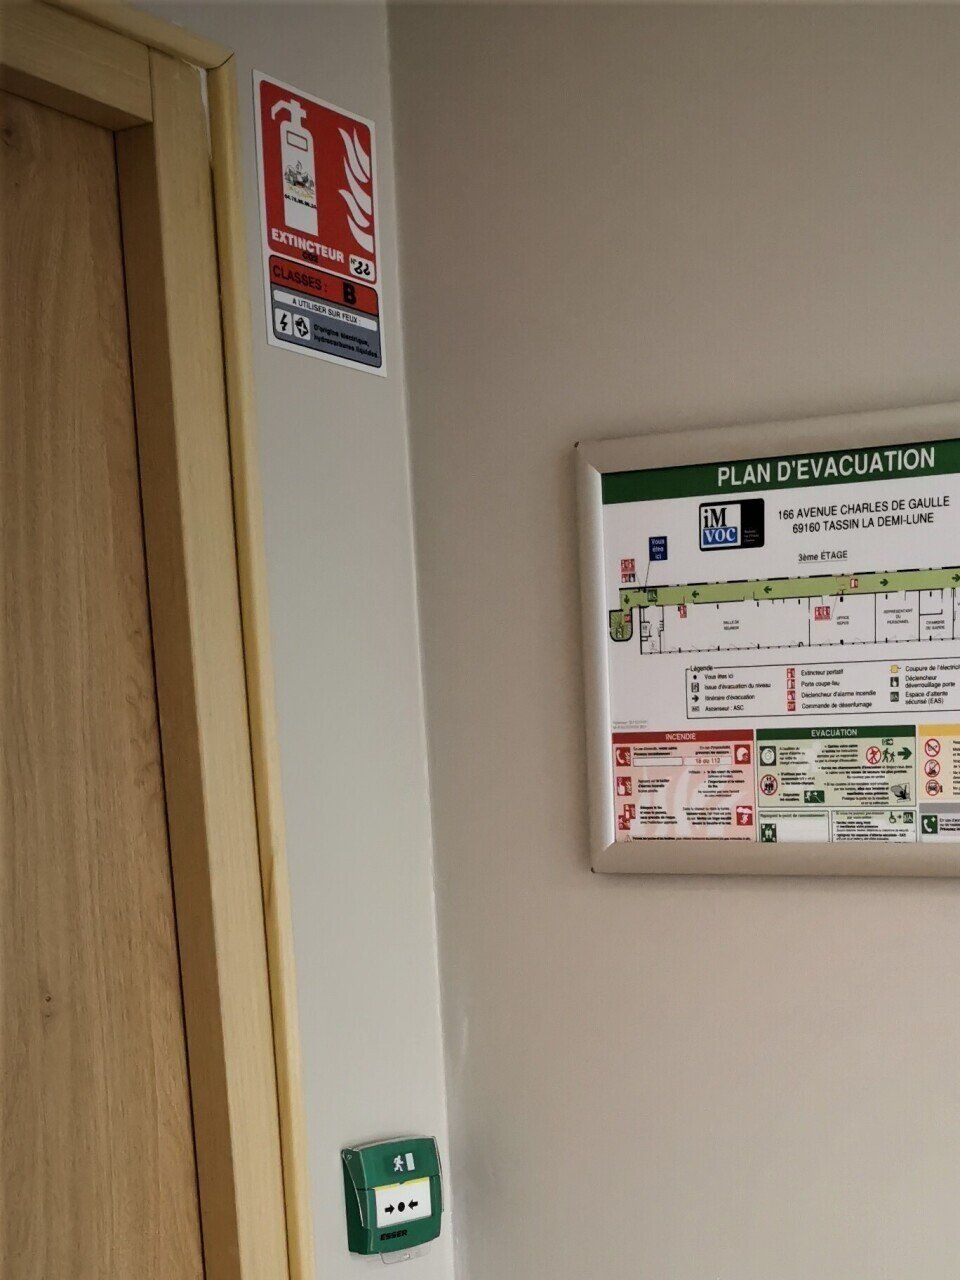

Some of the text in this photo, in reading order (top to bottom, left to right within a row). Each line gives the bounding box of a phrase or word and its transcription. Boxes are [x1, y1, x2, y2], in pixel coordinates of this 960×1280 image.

[271, 228, 344, 263] EXTINCTEUR
[272, 264, 321, 289] CLASSES
[342, 281, 356, 305] B
[298, 300, 326, 314] UTILISER
[327, 308, 340, 318] SUR
[342, 313, 357, 323] FEUX
[718, 446, 934, 487] PLAN D'EVACUATION
[778, 495, 949, 520] 166 AVENUE CHARLES DE GAULLE
[792, 512, 933, 534] 69160 TASSIN LA DEMI-LUNE
[703, 525, 736, 543] VOC
[798, 549, 847, 561] 3ème ÉTAGE
[905, 664, 927, 672] Coupure
[666, 732, 695, 740] INCENDIE
[811, 728, 857, 737] EVACUATION
[380, 1229, 408, 1241] ESSER
